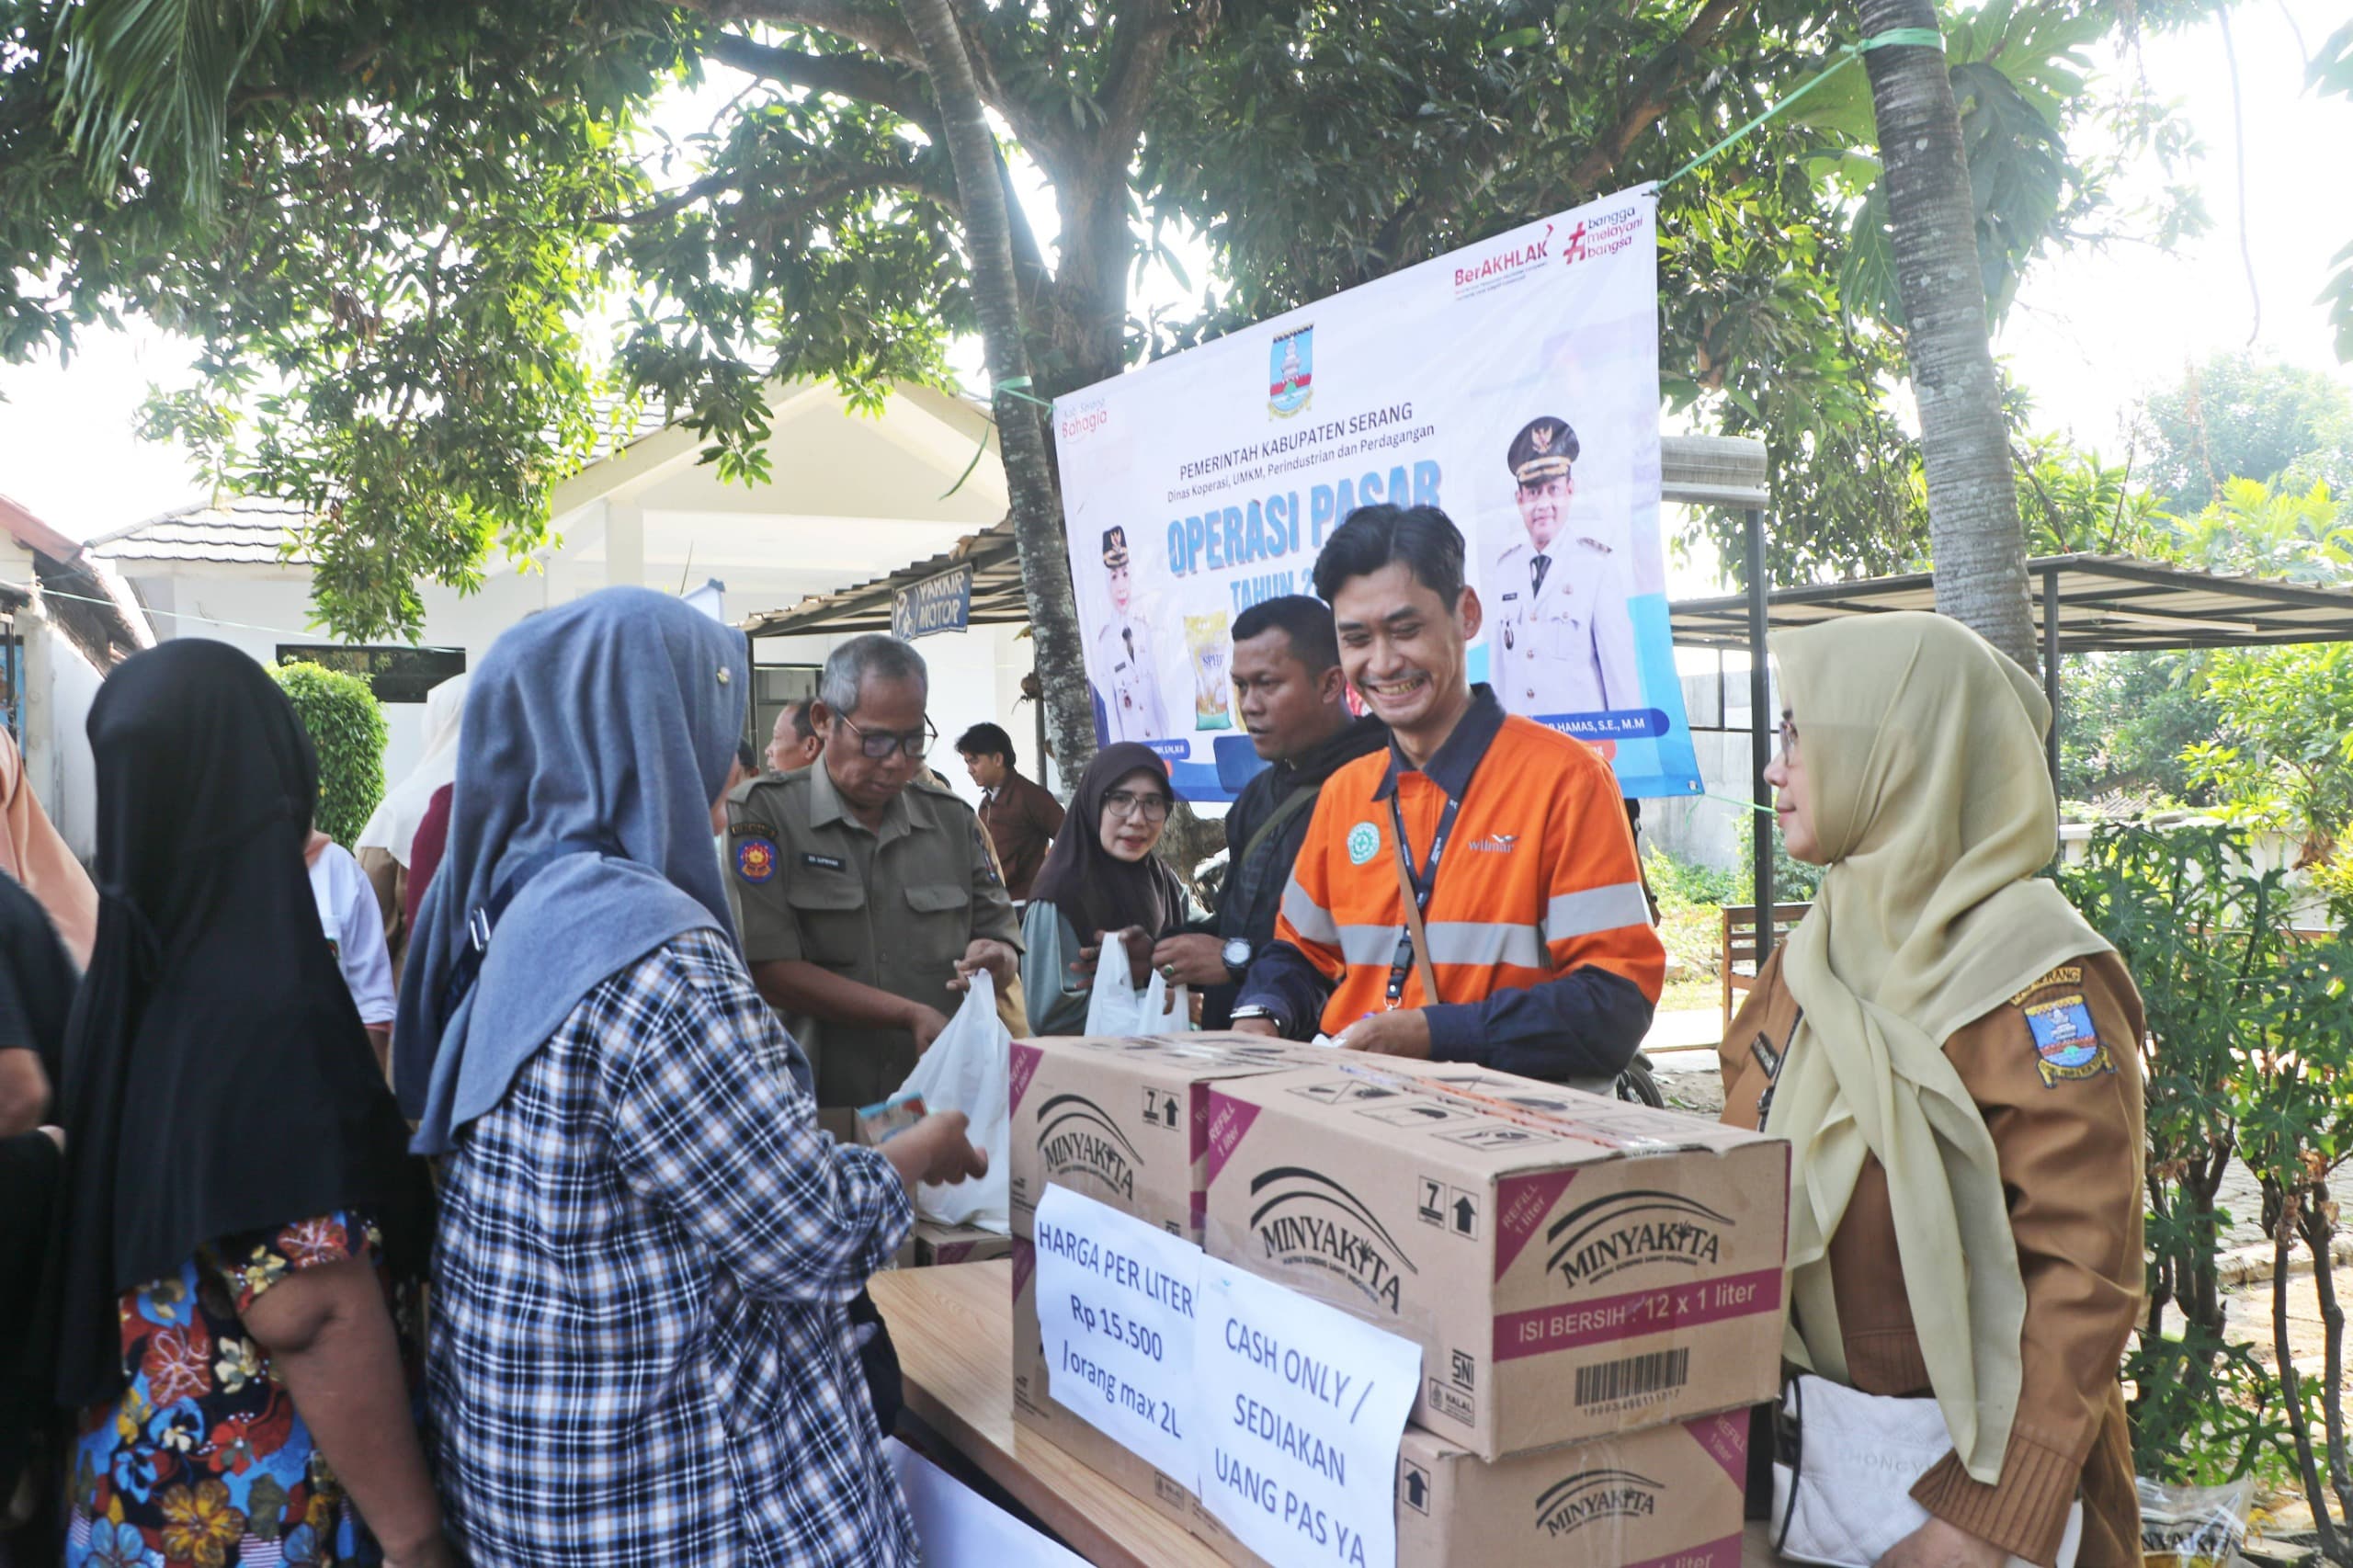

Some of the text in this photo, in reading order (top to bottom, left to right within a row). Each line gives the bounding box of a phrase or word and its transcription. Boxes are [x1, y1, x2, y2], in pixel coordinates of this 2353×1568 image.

[1587, 218, 1643, 244] melayani
[1588, 207, 1635, 230] bangga
[1455, 239, 1549, 287] BerAKHLAK
[1587, 235, 1633, 258] bangsa
[1062, 407, 1107, 438] Bahagia
[1180, 402, 1413, 481] PEMERINTAH KABUPATEN SERANG
[1167, 424, 1435, 504] Dinas Koperasi, UMKM, Perindustrian dan Perdagangan
[1167, 460, 1442, 577] OPERASI PASAR
[1230, 569, 1294, 616] TAHUN
[919, 598, 961, 630] MOTOR
[1557, 720, 1597, 733] HAMAS,
[1621, 718, 1645, 730] M.M
[1468, 837, 1515, 854] wilmar
[1146, 1090, 1156, 1112] 7
[1209, 1102, 1236, 1144] REFILL
[1218, 1123, 1239, 1158] 1 liter
[1427, 1182, 1439, 1209] 7
[1502, 1184, 1539, 1229] REFILL
[1515, 1195, 1544, 1234] 1 liter
[1039, 1221, 1194, 1319] HARGA PER LITER
[1070, 1294, 1163, 1363] Rp 15.500
[1519, 1320, 1544, 1343] ISI
[1550, 1306, 1626, 1336] BERSIH
[1645, 1293, 1670, 1320] 12
[1677, 1295, 1689, 1315] x
[1698, 1288, 1707, 1311] 1
[1715, 1283, 1756, 1307] liter
[1225, 1318, 1374, 1424] CASH ONLY /
[1452, 1354, 1473, 1386] SNI
[1120, 1381, 1155, 1424] max
[1160, 1402, 1182, 1439] 2L
[1233, 1393, 1346, 1488] SEDIAKAN
[1716, 1415, 1745, 1453] REFILL
[1215, 1447, 1278, 1514] UANG
[1284, 1490, 1327, 1545] PAS
[1335, 1519, 1366, 1568] YA
